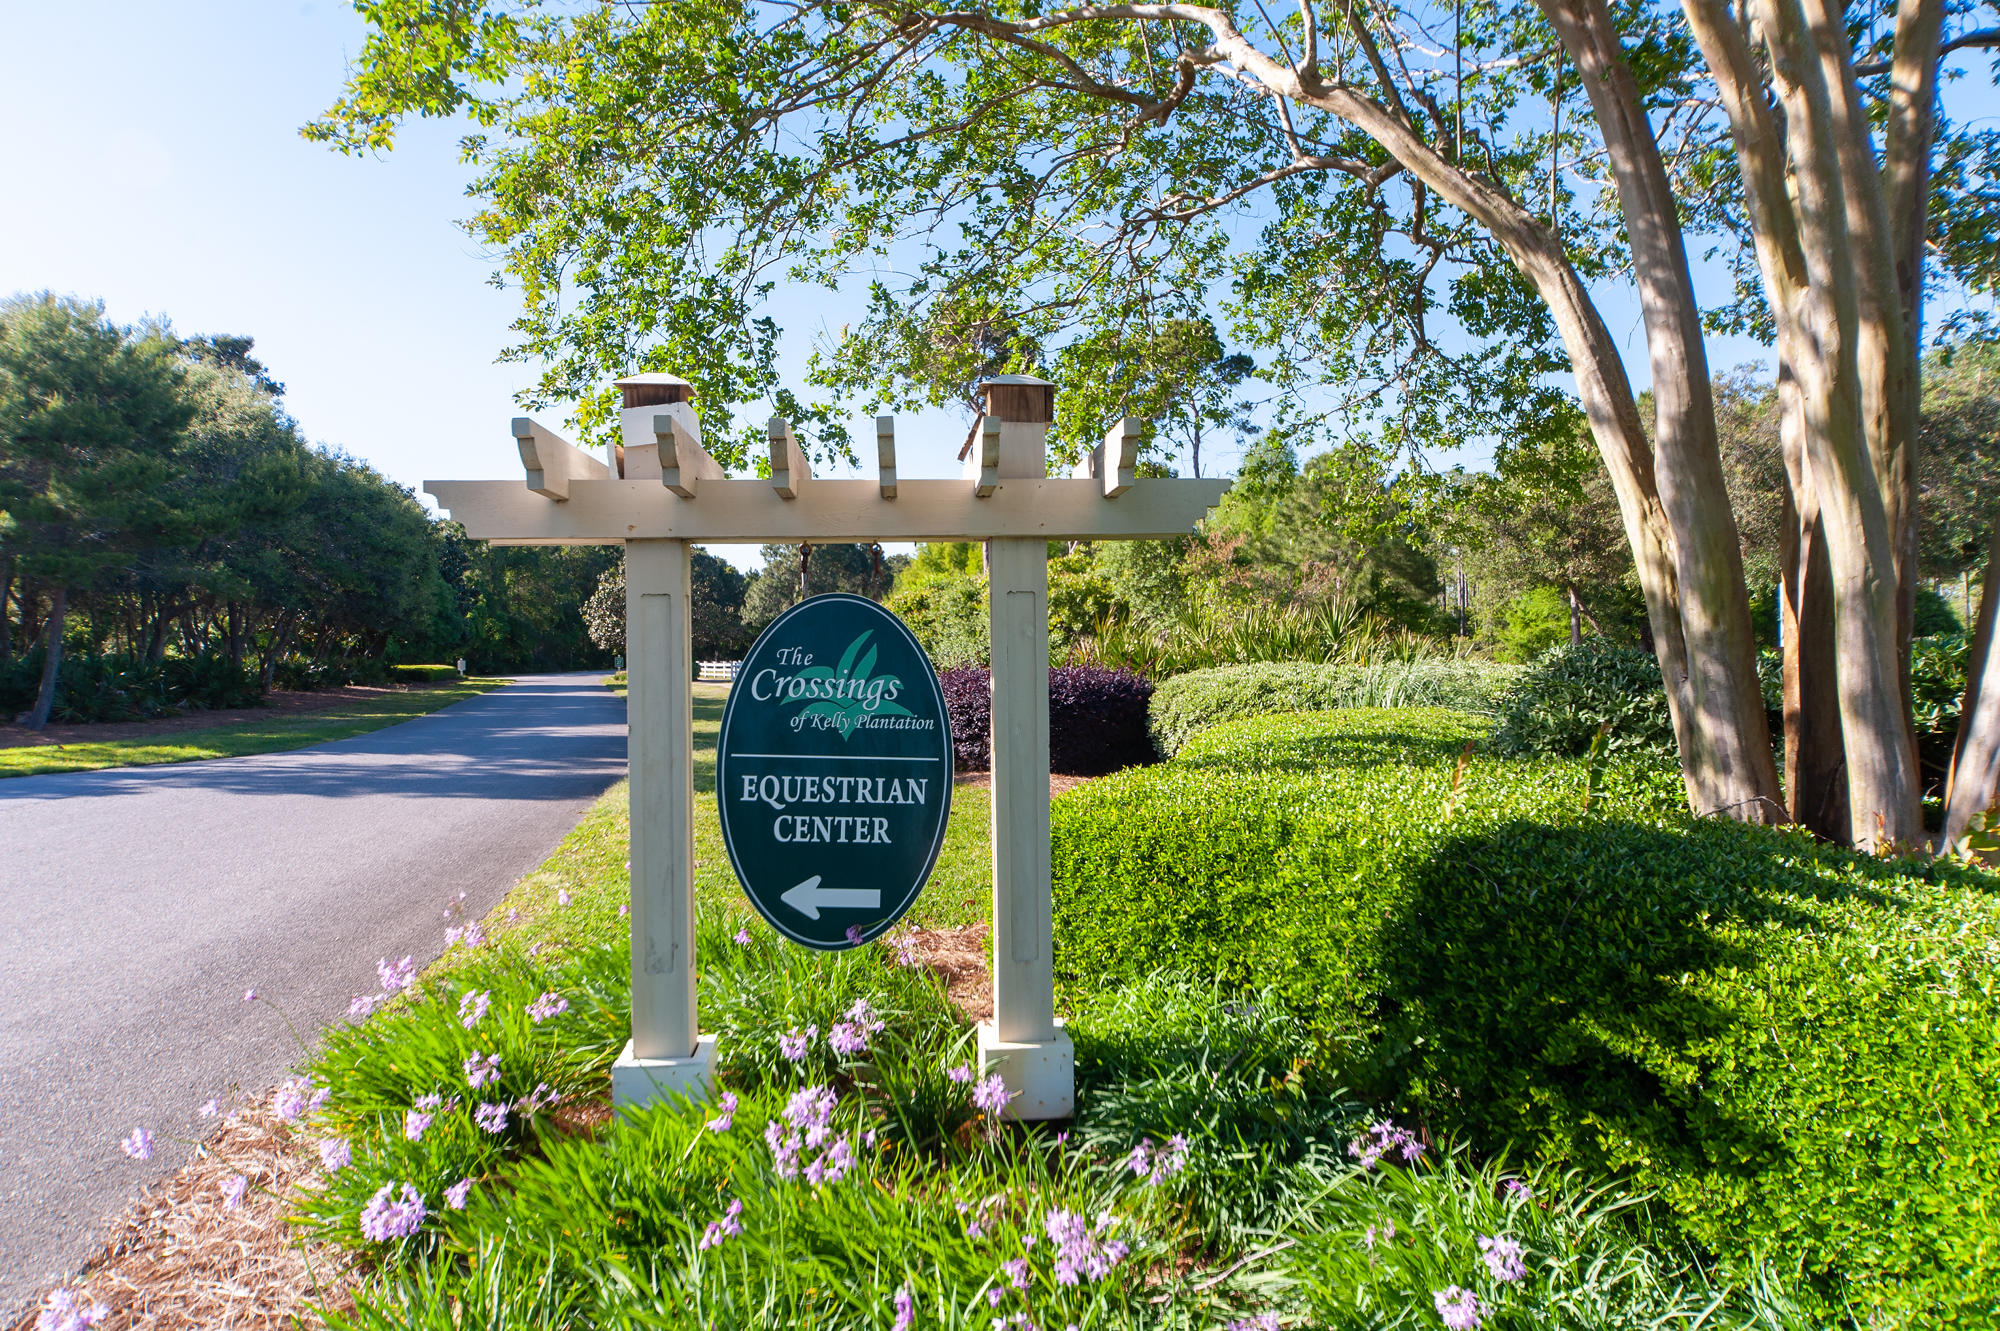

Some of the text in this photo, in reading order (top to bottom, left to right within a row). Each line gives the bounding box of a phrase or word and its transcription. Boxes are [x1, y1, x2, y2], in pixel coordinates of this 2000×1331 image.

[776, 646, 814, 666] The
[751, 669, 900, 711] Crossings
[790, 711, 935, 733] of Kelly Plantation
[740, 775, 928, 810] EQUESTRIAN
[773, 815, 892, 844] CENTER
